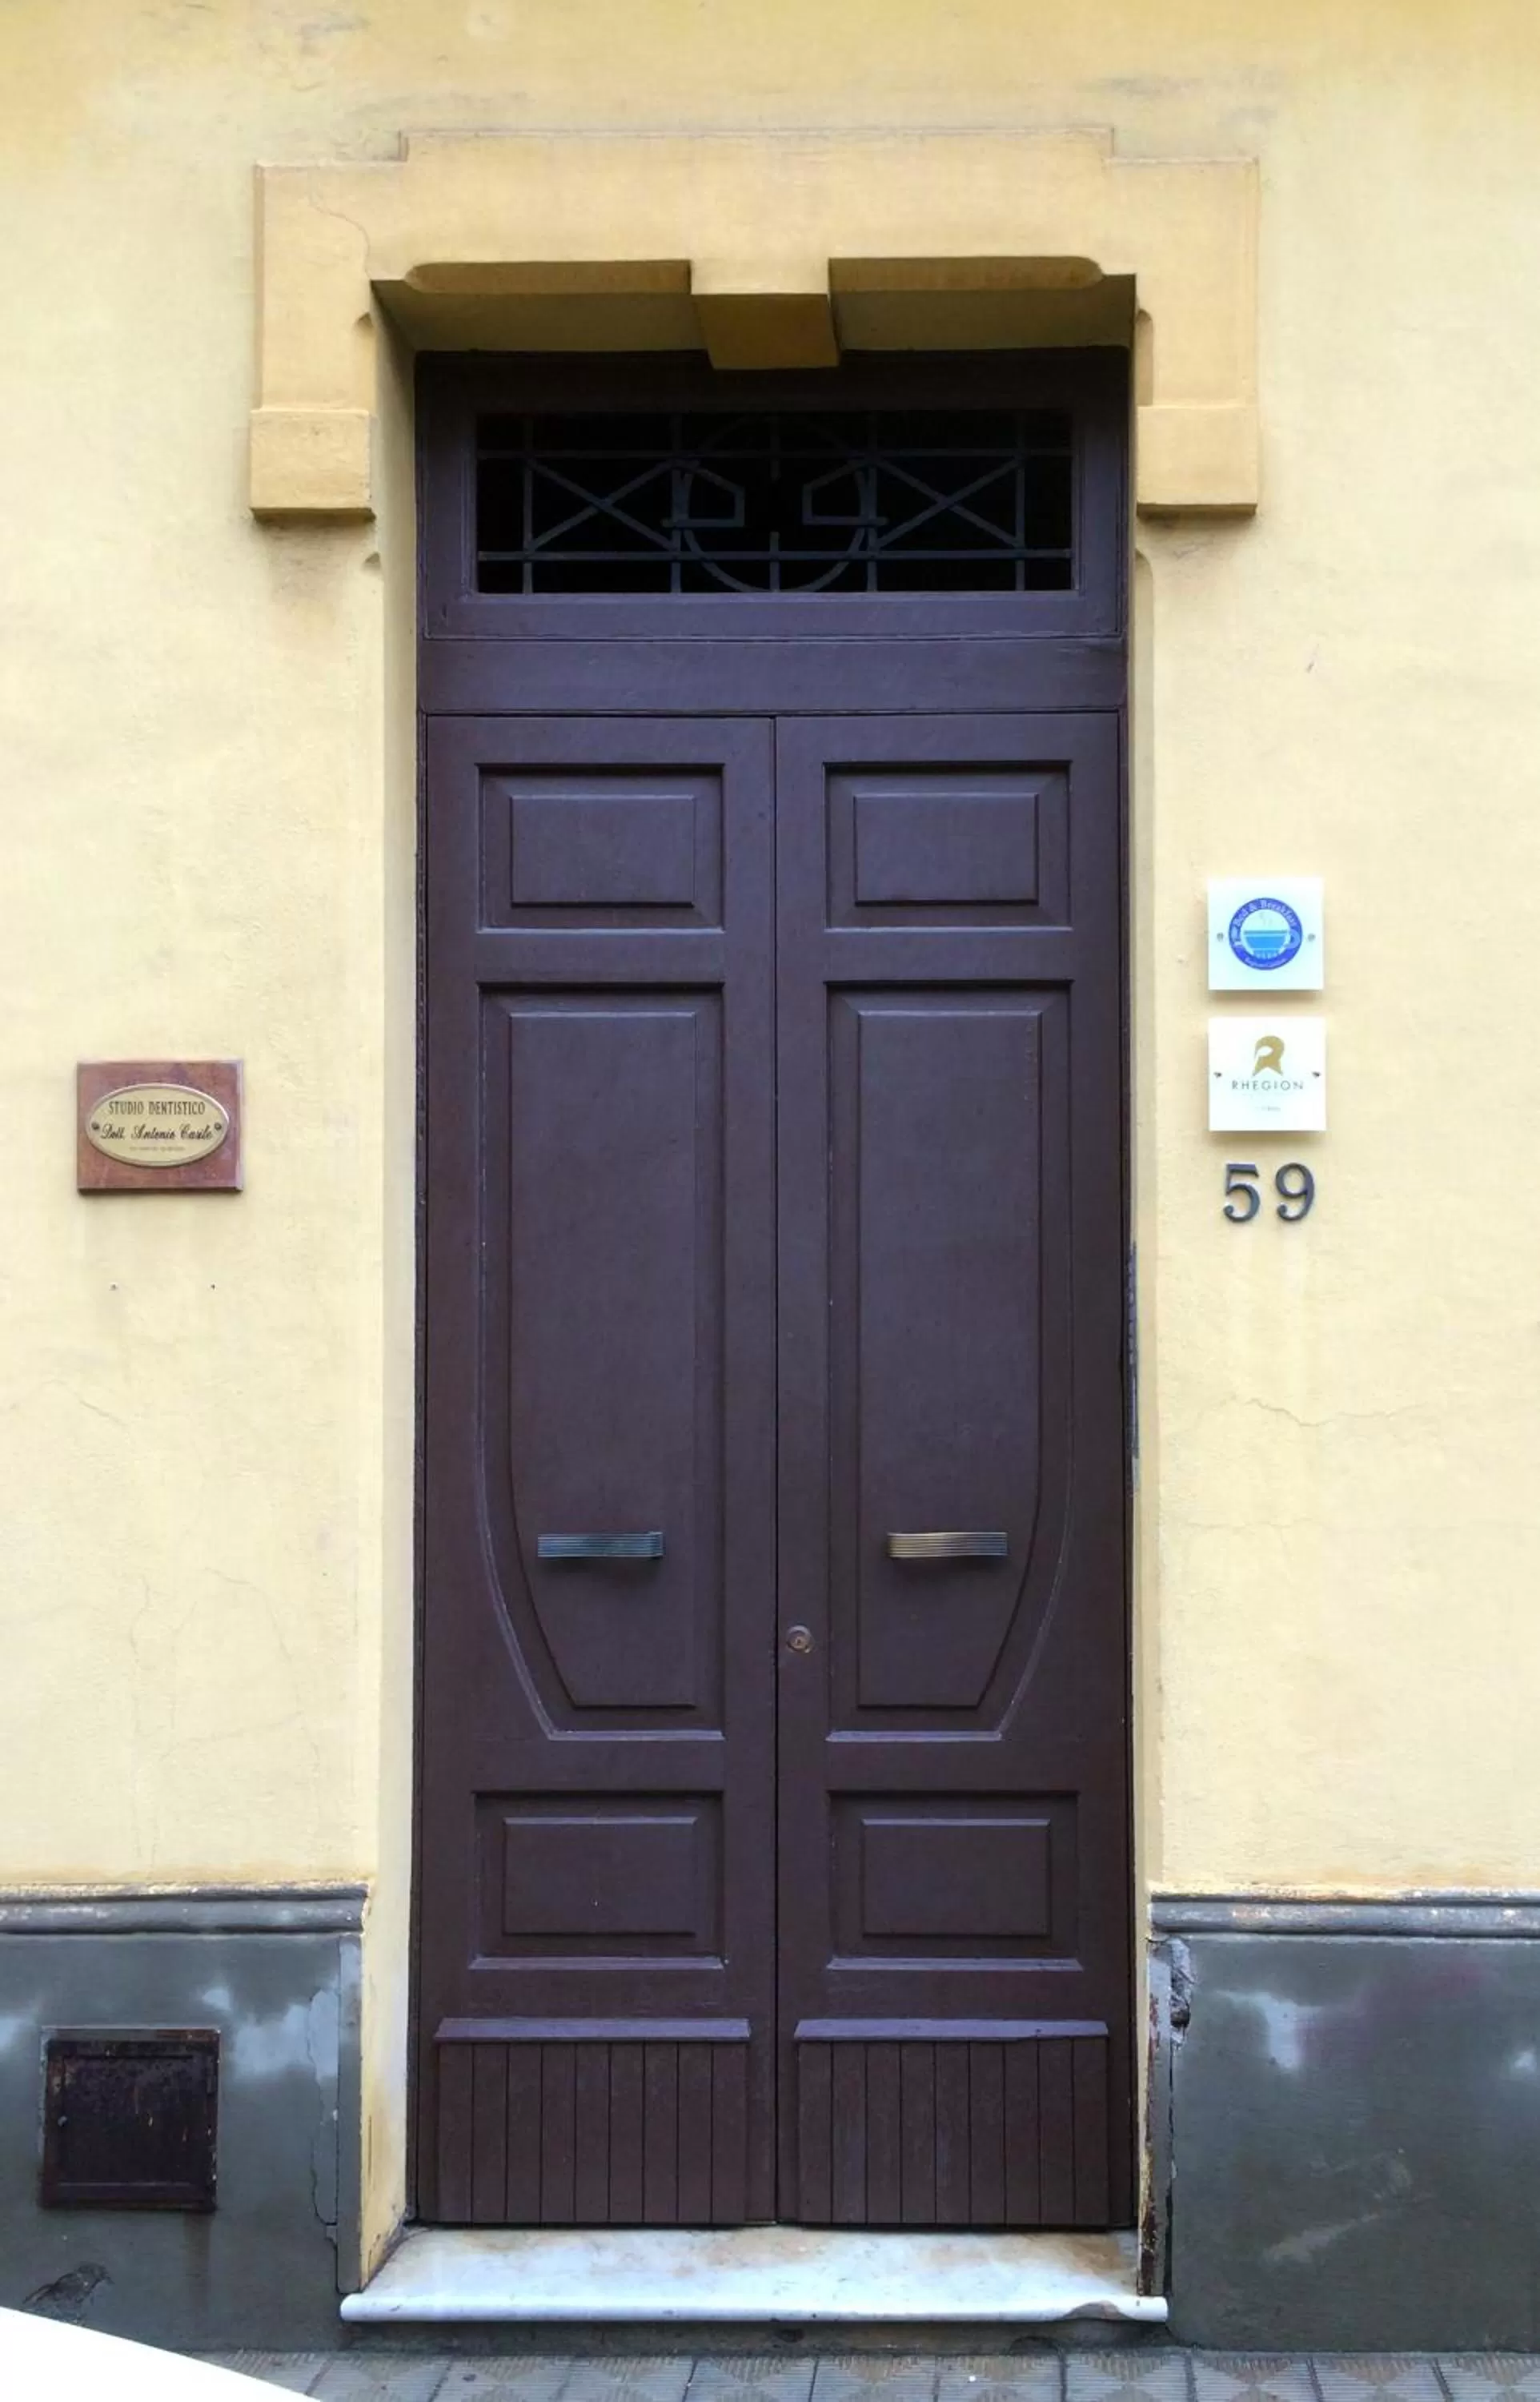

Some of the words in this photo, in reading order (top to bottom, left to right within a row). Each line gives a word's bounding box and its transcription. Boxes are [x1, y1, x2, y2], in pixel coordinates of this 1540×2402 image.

[1231, 1079, 1305, 1091] RHEGION
[108, 1100, 145, 1115] STUDIO
[148, 1100, 206, 1115] DENTISTICO
[130, 1123, 175, 1140] Antonio
[1223, 1163, 1314, 1223] 59
